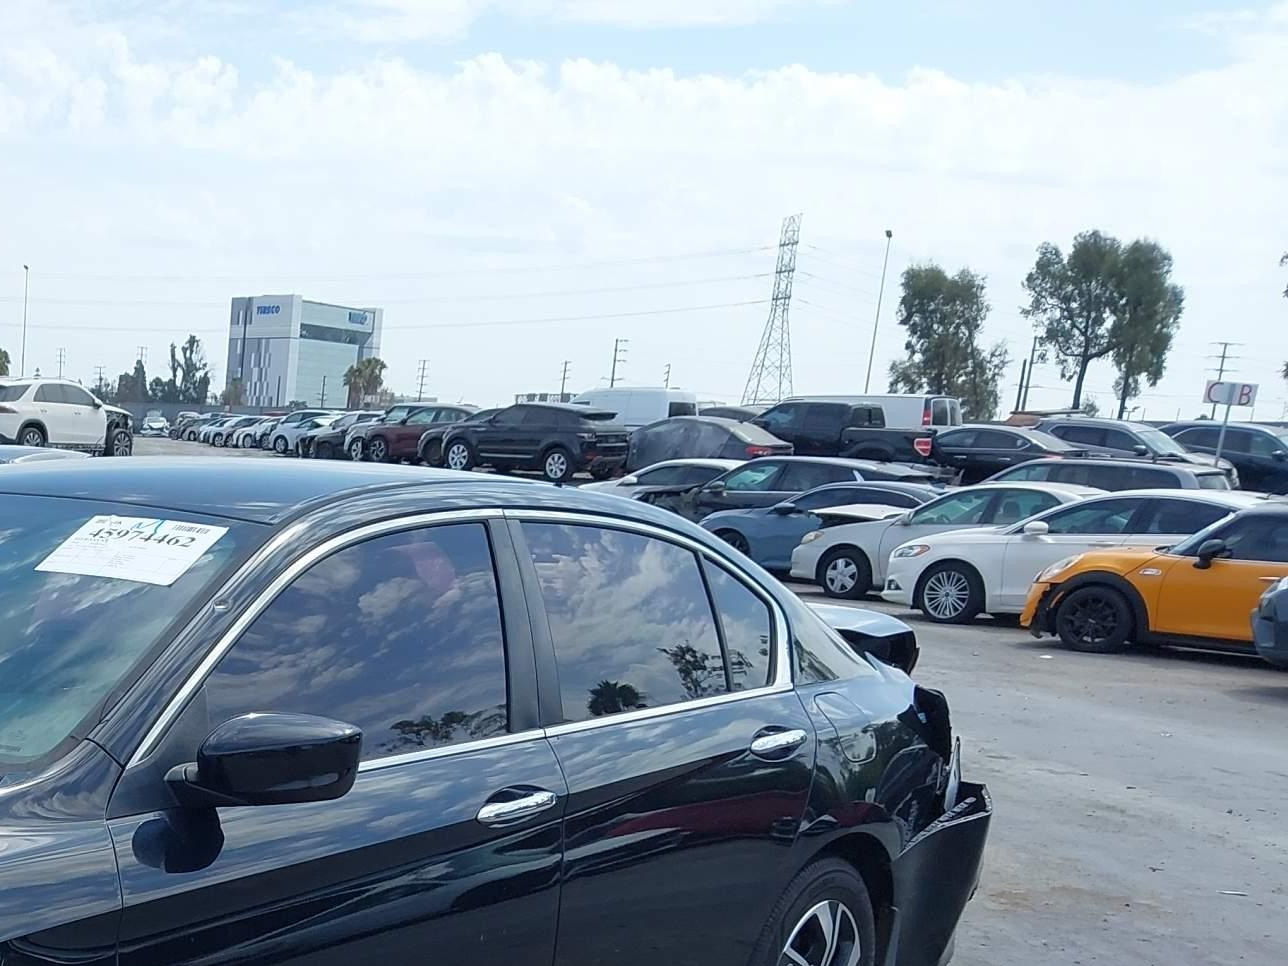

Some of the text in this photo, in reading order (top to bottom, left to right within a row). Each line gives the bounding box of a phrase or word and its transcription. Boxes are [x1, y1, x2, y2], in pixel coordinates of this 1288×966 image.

[1207, 382, 1252, 406] C B
[89, 528, 197, 548] 45974462
